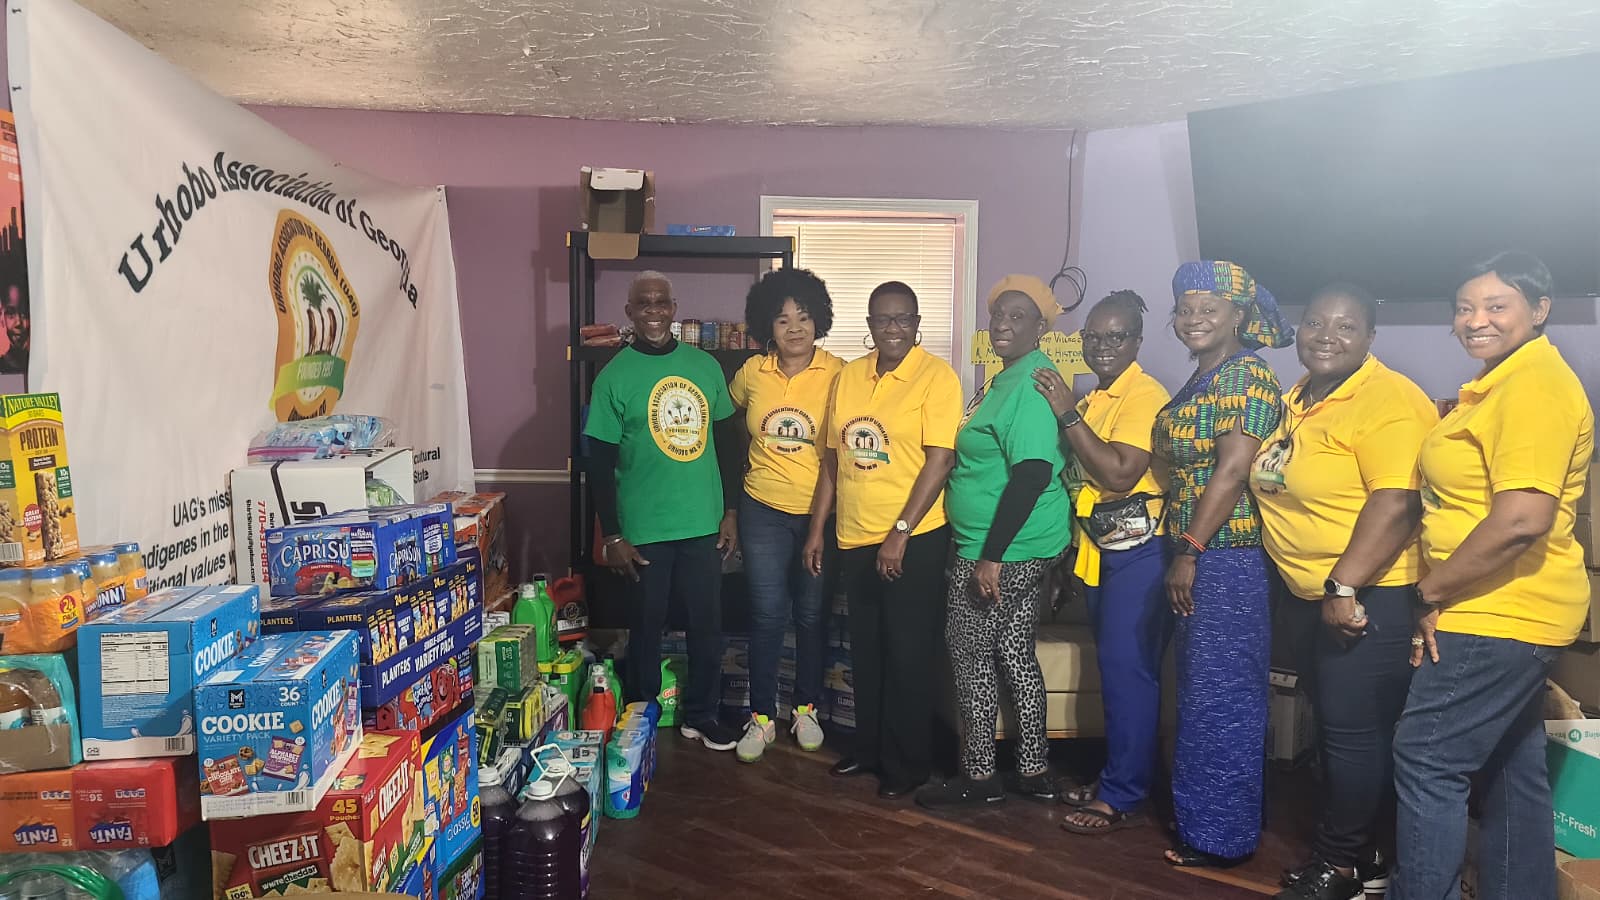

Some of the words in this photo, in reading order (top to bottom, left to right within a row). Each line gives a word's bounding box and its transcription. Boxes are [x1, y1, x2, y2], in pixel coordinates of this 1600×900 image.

[118, 161, 217, 293] Urhobo
[214, 152, 336, 215] Association
[335, 198, 357, 230] of
[360, 210, 418, 309] Georia
[20, 426, 59, 451] PROTEIN
[173, 496, 206, 528] UAG's
[200, 527, 210, 549] in
[213, 521, 229, 543] the
[191, 553, 226, 583] values
[61, 598, 74, 613] 24
[326, 614, 363, 625] PLANTERS
[195, 631, 235, 677] COOKIE
[382, 656, 412, 689] PLANTERS
[414, 644, 440, 673] VARIETY
[439, 635, 455, 656] PACK
[278, 686, 301, 702] 36
[311, 679, 341, 731] COOKIE
[201, 711, 285, 735] COOKIE
[203, 734, 243, 743] VARIETY
[246, 731, 271, 741] PACK
[329, 814, 361, 822] Pouches
[332, 798, 358, 815] 45
[14, 827, 59, 846] FANTA
[90, 825, 134, 844] FANTA
[447, 811, 471, 841] Classic
[284, 865, 317, 884] cheddar
